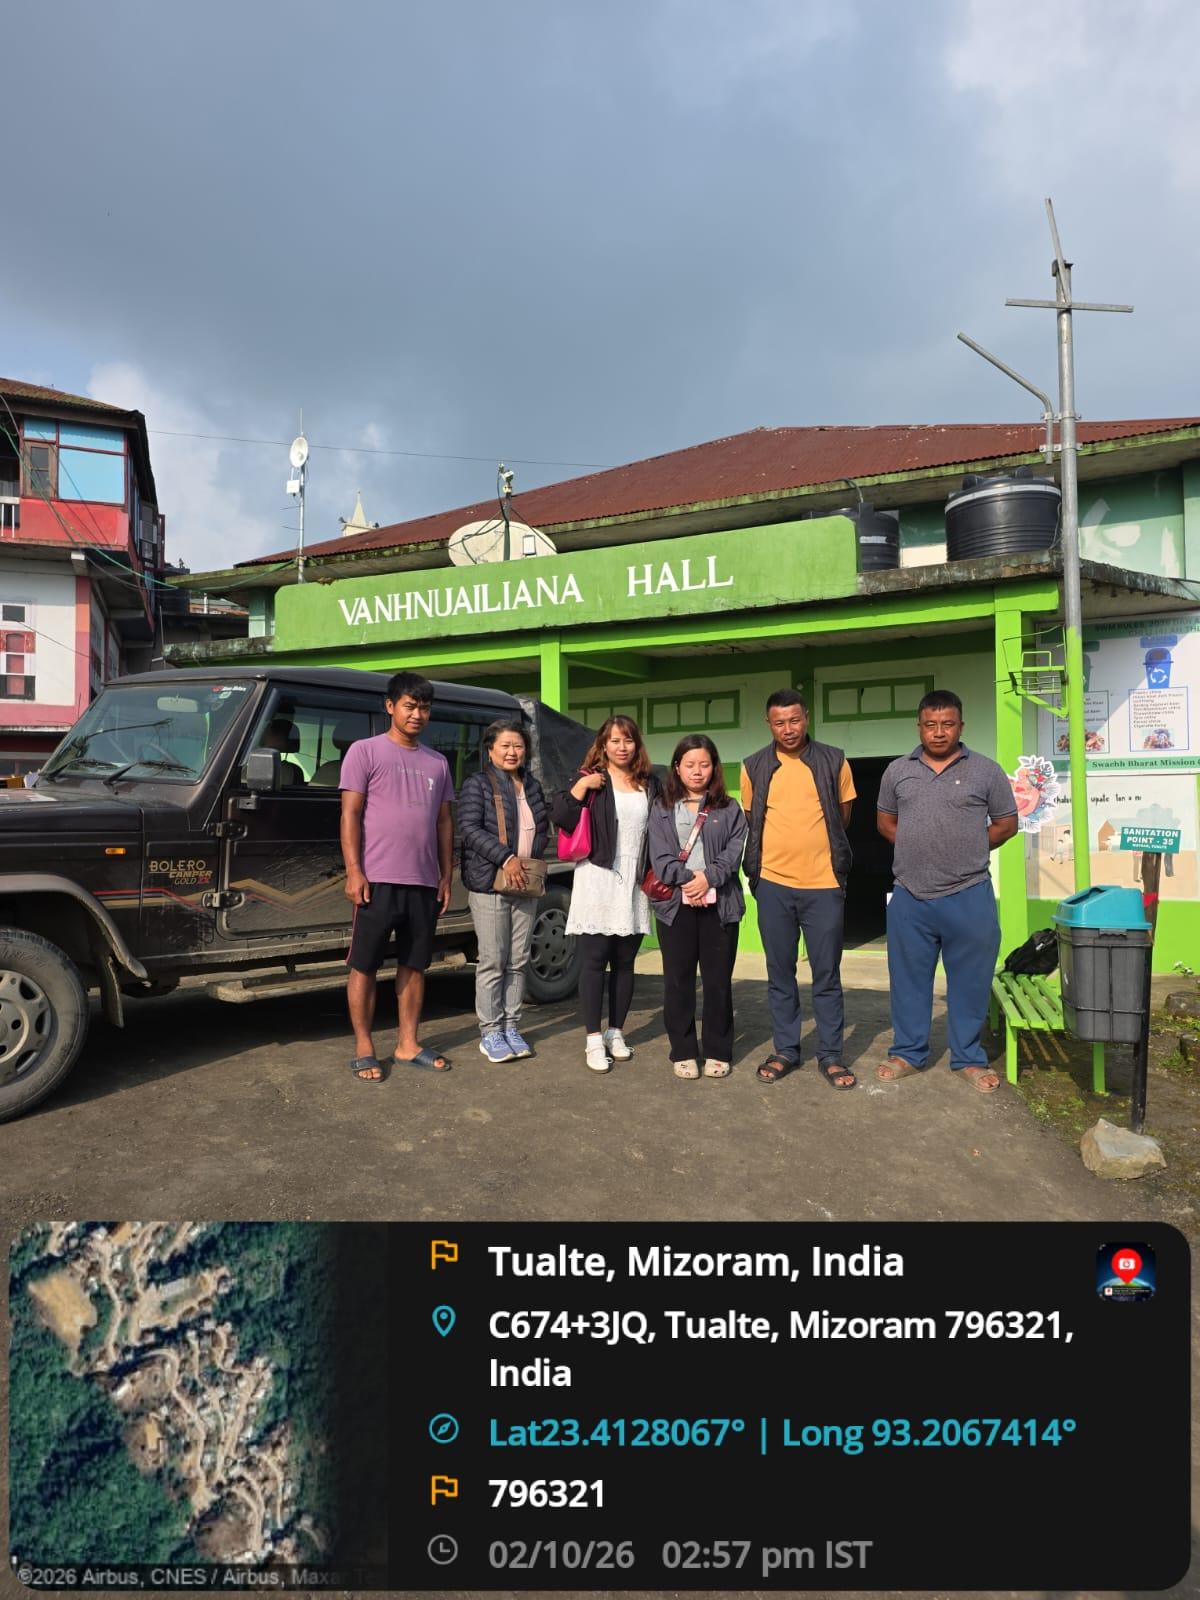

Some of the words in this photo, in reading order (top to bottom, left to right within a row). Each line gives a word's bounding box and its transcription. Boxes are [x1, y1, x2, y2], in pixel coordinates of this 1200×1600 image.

[337, 573, 585, 627] VANHNUAILIANA
[626, 555, 734, 598] HALL
[1128, 760, 1158, 768] Bharat
[1160, 759, 1196, 767] Mission
[1123, 828, 1179, 838] SANITATION
[1126, 836, 1154, 844] POINT
[1162, 838, 1174, 846] 35
[149, 859, 207, 872] BOLERO
[169, 870, 213, 879] CAMPER
[174, 877, 197, 885] GOLD
